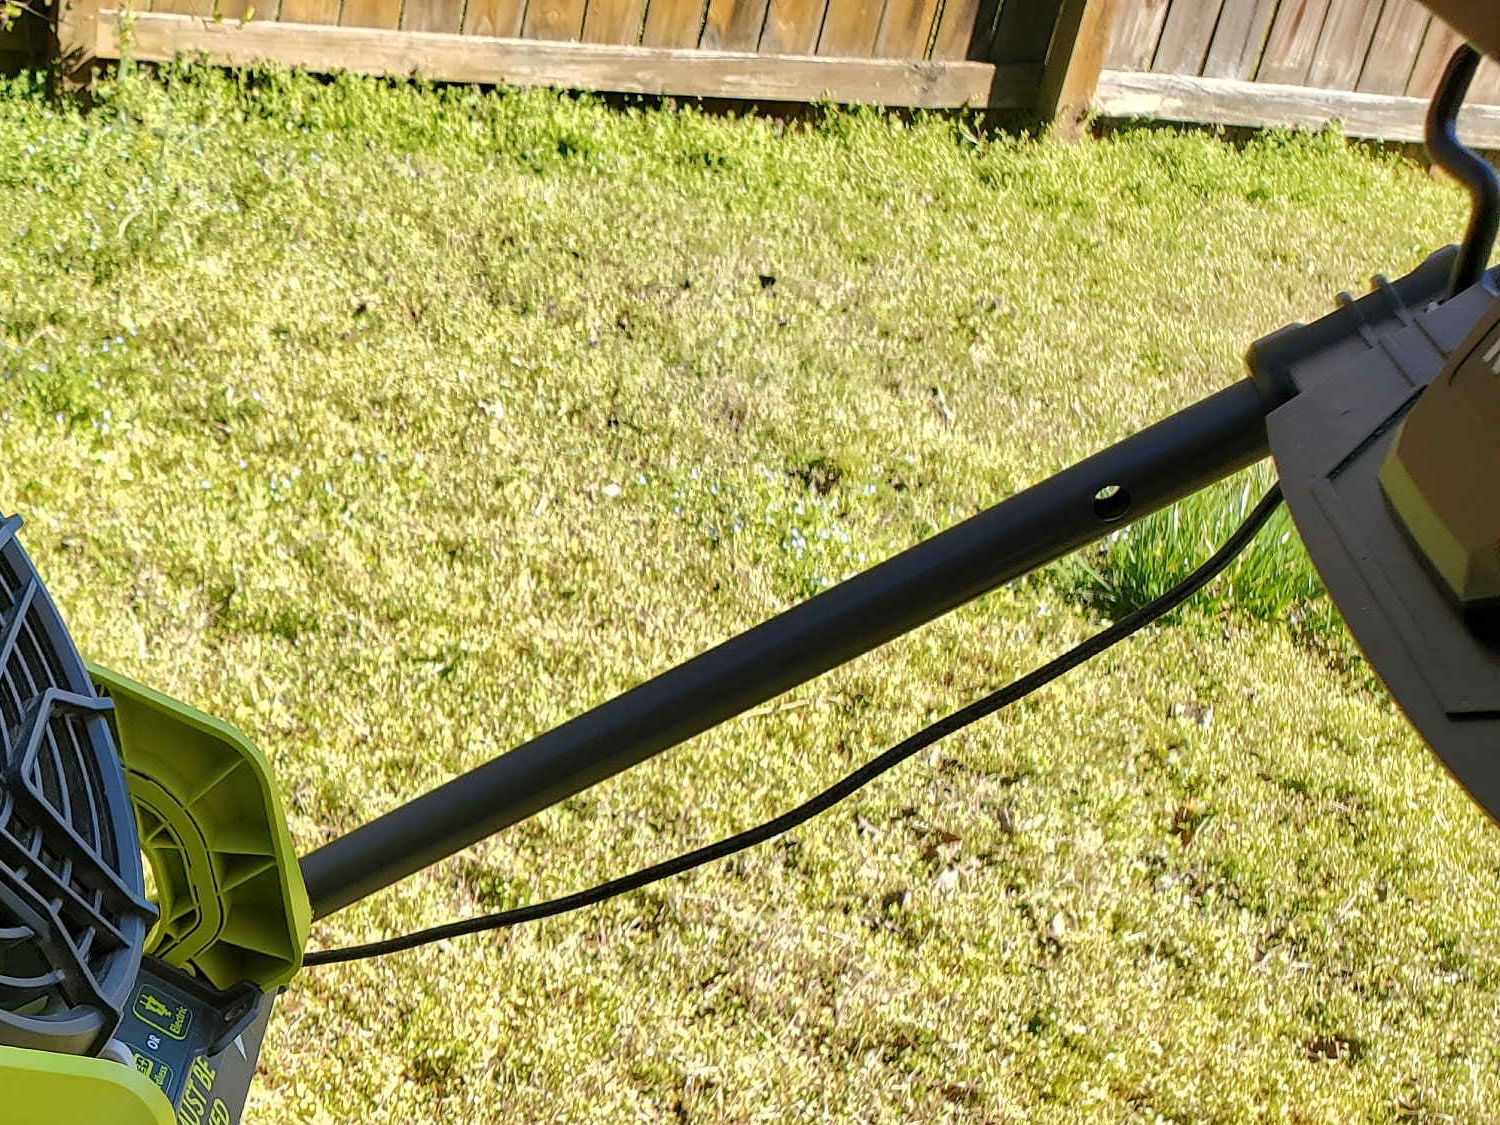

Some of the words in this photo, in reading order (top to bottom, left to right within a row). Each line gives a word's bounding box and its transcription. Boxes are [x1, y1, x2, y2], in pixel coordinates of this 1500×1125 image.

[169, 1005, 188, 1035] Electric
[147, 1034, 161, 1050] OR
[154, 1065, 168, 1089] dless
[193, 1055, 216, 1092] BE
